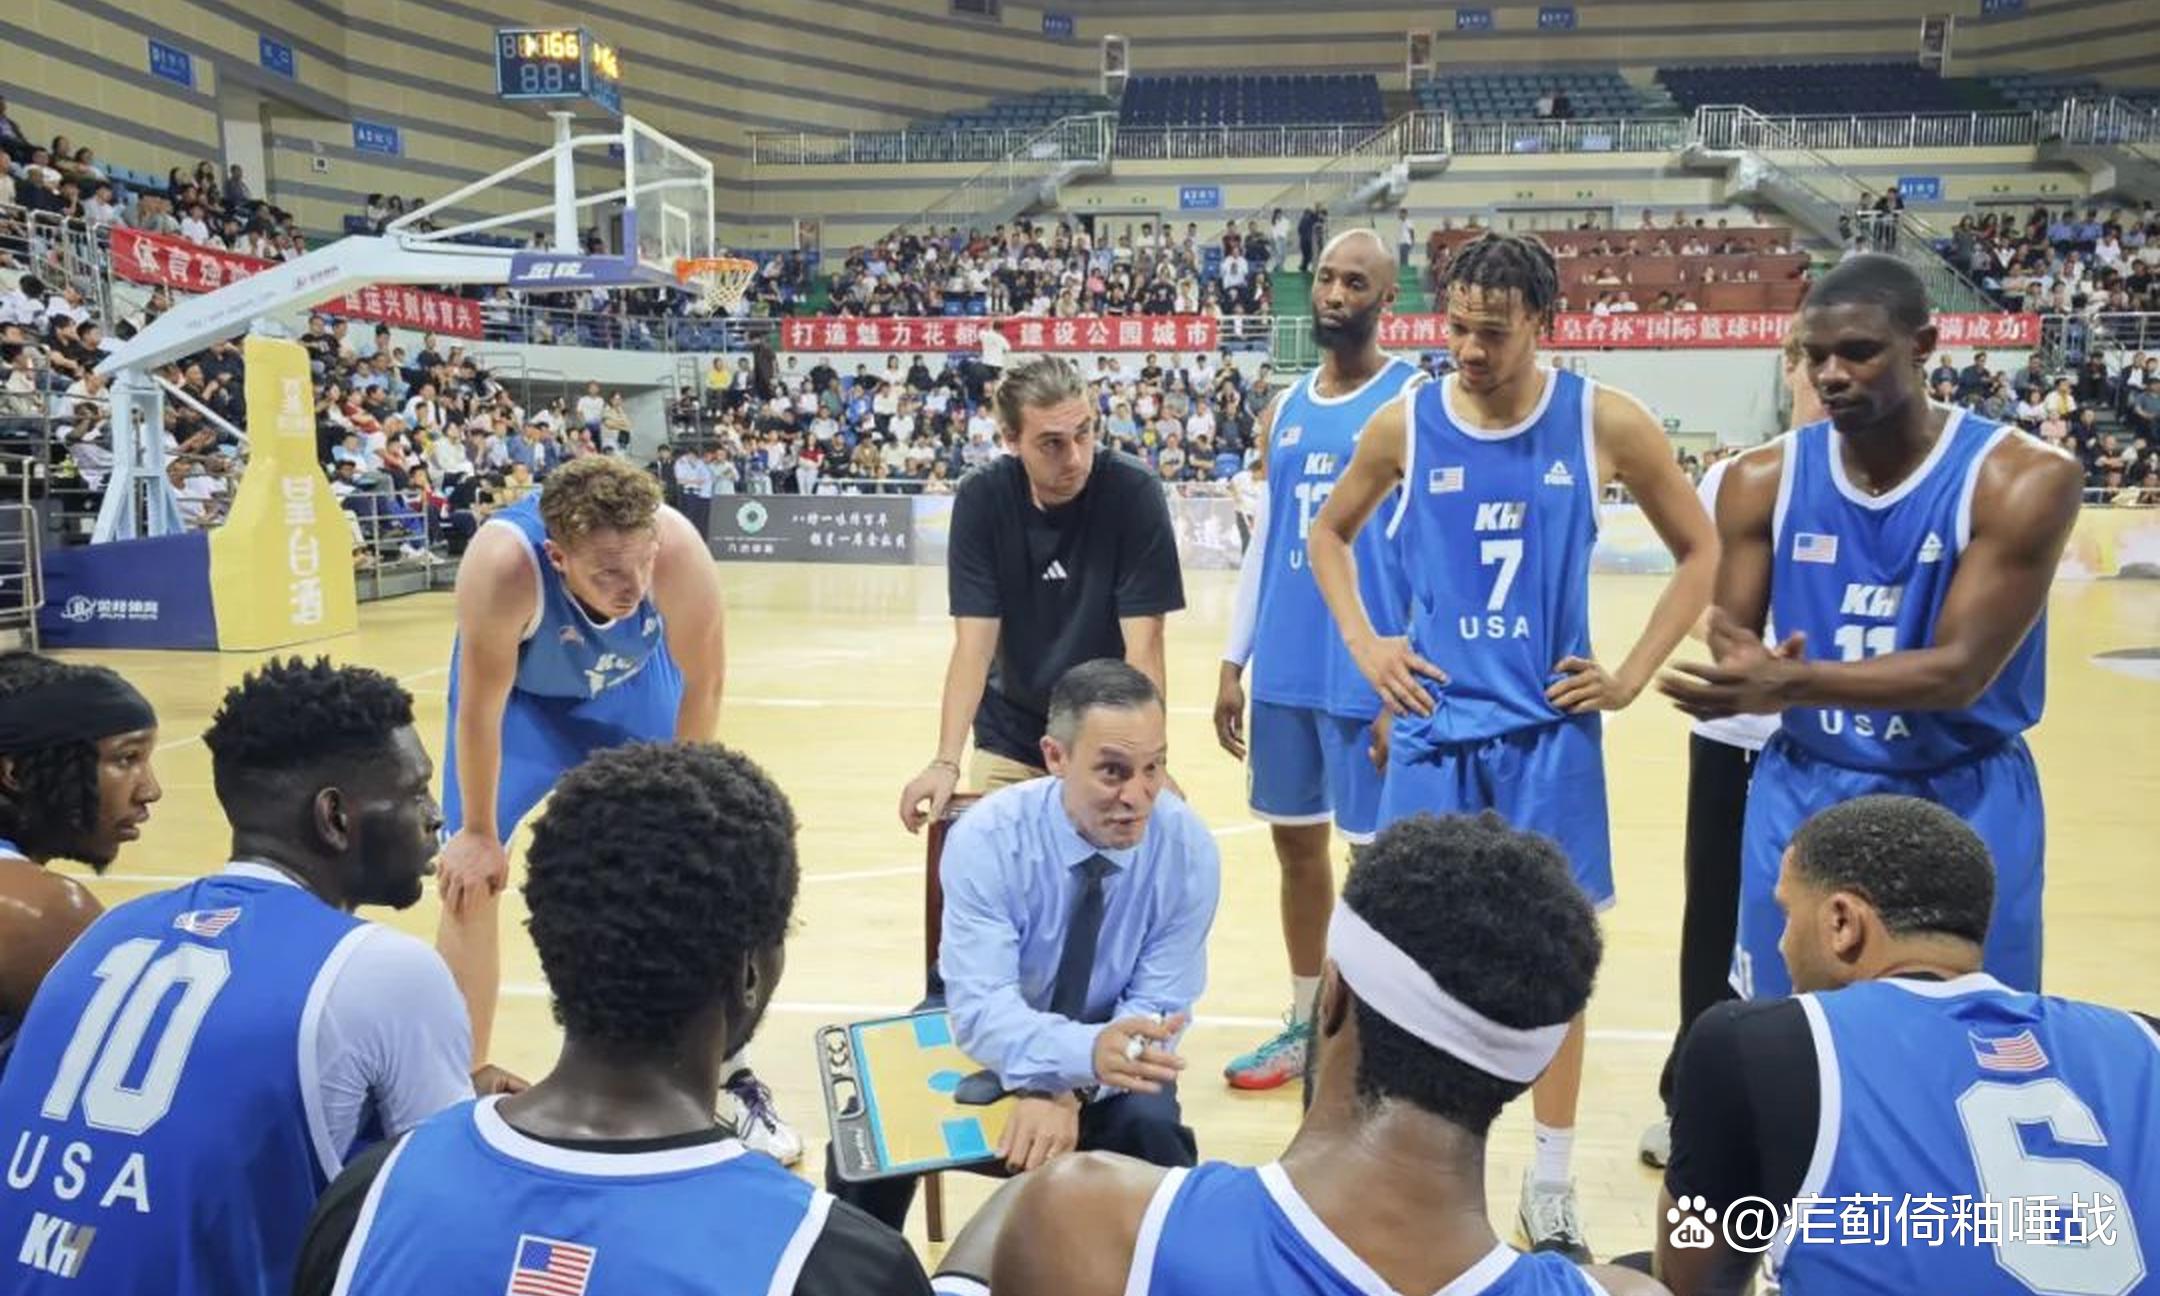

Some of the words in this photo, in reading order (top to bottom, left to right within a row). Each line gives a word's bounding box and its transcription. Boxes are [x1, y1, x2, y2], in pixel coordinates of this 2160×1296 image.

[791, 322, 978, 346] 打造魅力花都
[1020, 321, 1210, 346] 建设公园城市
[1474, 502, 1526, 531] KH
[1481, 539, 1523, 611] 7
[1840, 583, 1903, 617] KH
[1459, 616, 1530, 640] USA
[1819, 708, 1911, 741] USA
[41, 937, 232, 1136] 10
[7, 1130, 150, 1213] USA
[1955, 1078, 2147, 1296] 6
[18, 1211, 97, 1279] KH
